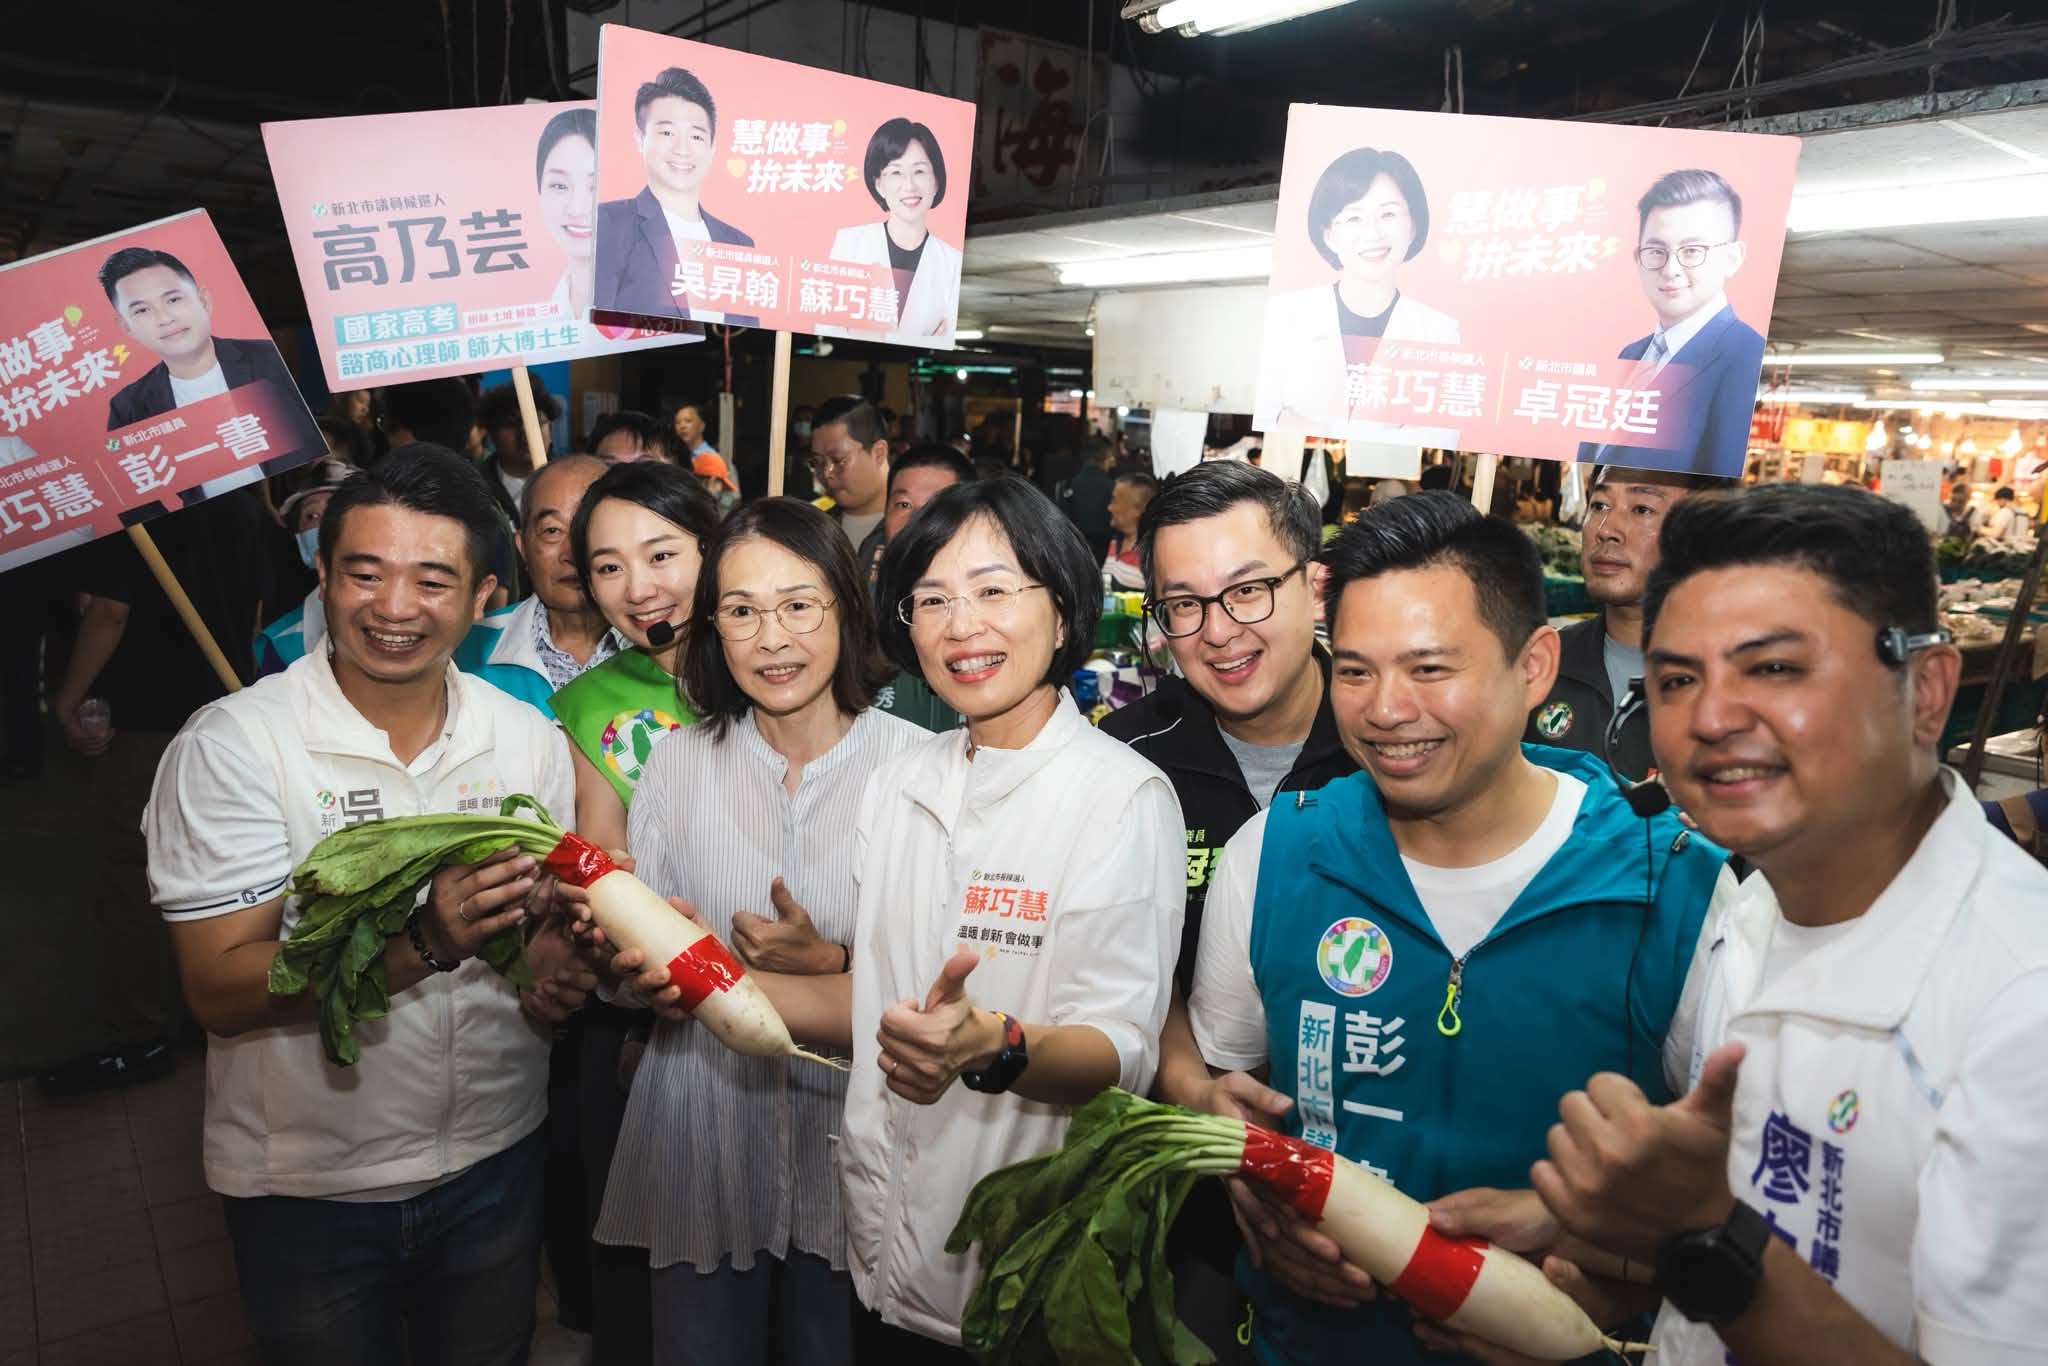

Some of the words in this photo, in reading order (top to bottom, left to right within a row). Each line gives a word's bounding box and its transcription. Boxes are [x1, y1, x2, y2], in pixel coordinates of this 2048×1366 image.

[730, 118, 832, 159] 慧做事
[331, 193, 447, 217] 新北市議員候選人
[1443, 184, 1585, 234] 慧做事
[312, 208, 530, 290] 高乃芸
[672, 261, 779, 309] 吳昇翰
[800, 277, 899, 322] 蘇巧慧
[343, 306, 457, 342] 國家高考
[339, 340, 460, 376] 諮商心理師
[467, 325, 581, 359] 師大博士生
[1346, 362, 1488, 418] 蘇巧慧
[1513, 379, 1663, 435] 卓冠廷
[118, 413, 271, 495] 彭一書
[963, 886, 1048, 921] 蘇巧慧
[981, 927, 1003, 944] 創新
[1005, 931, 1044, 949] 會做事
[1342, 1010, 1406, 1185] 彭一
